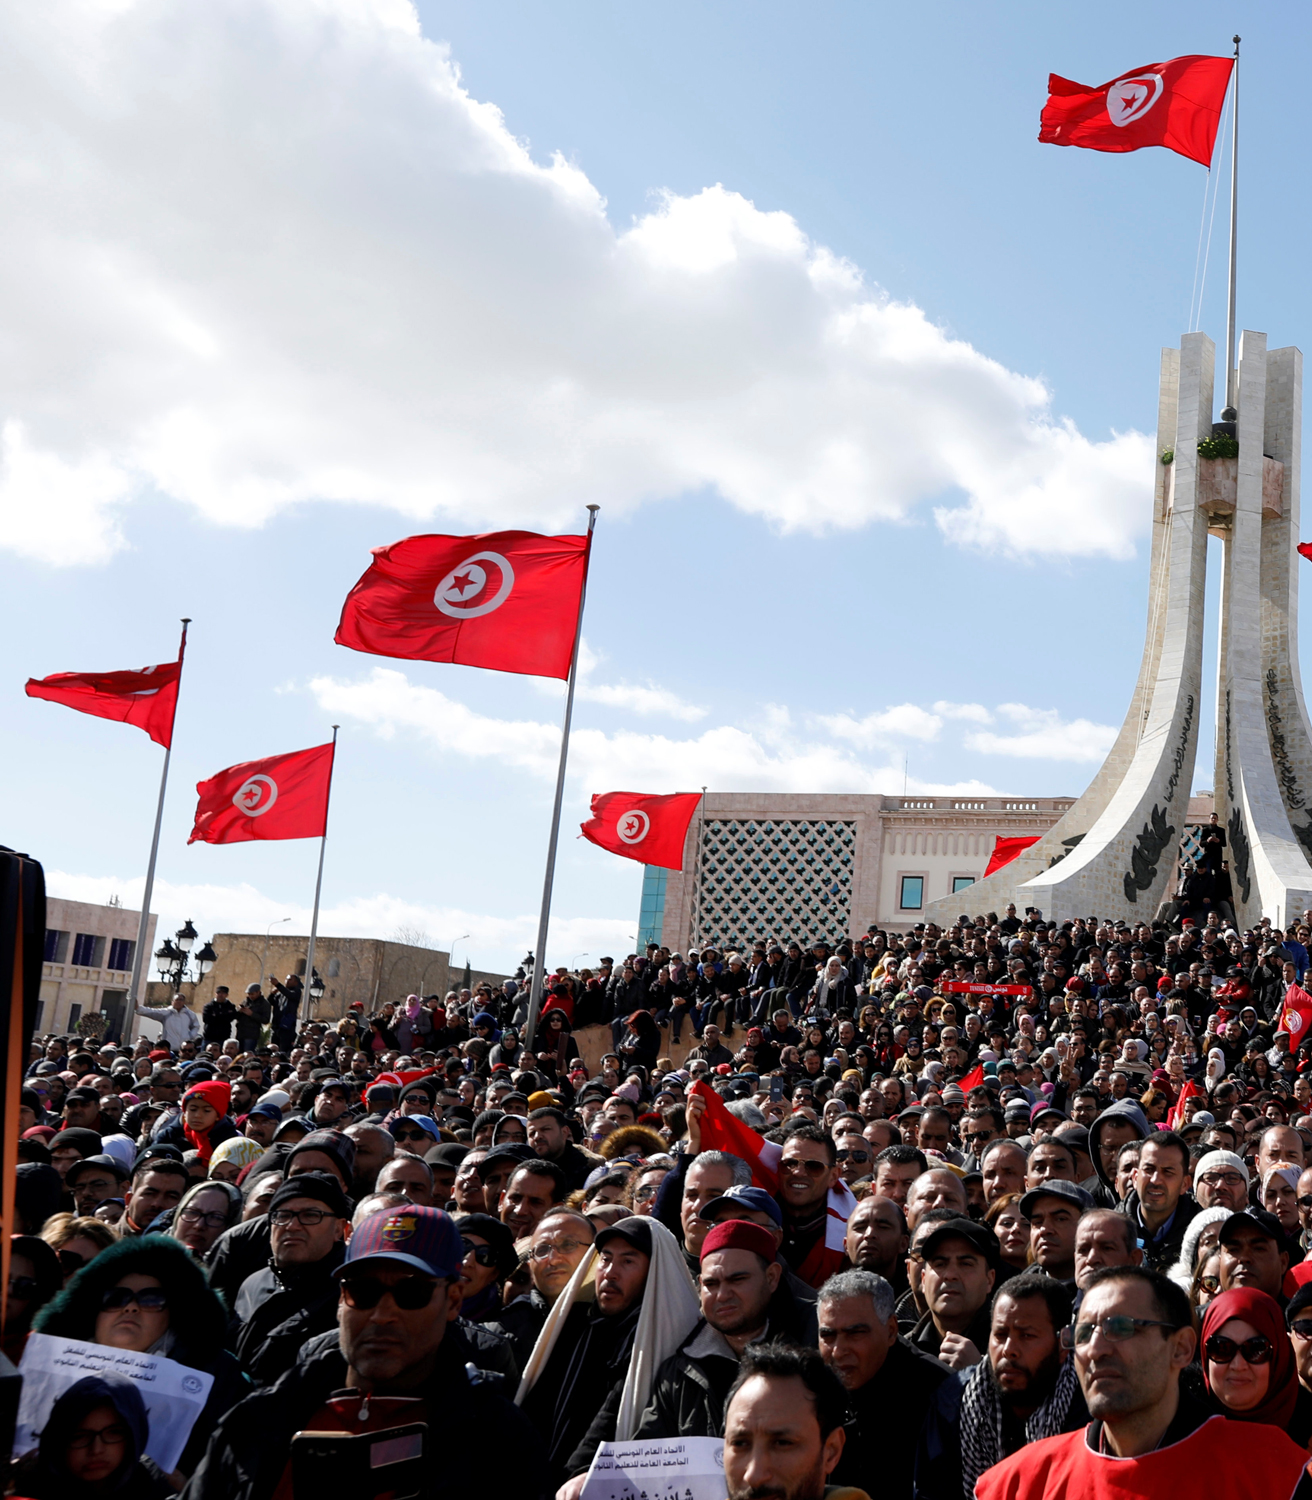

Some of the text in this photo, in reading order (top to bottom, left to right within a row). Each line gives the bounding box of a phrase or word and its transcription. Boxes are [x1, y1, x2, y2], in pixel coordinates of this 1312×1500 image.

[616, 1448, 643, 1459] التونسي
[644, 1447, 663, 1457] العام
[664, 1445, 685, 1454] الاتحاد
[614, 1461, 639, 1471] للتعليم
[663, 1457, 689, 1467] الجامعة
